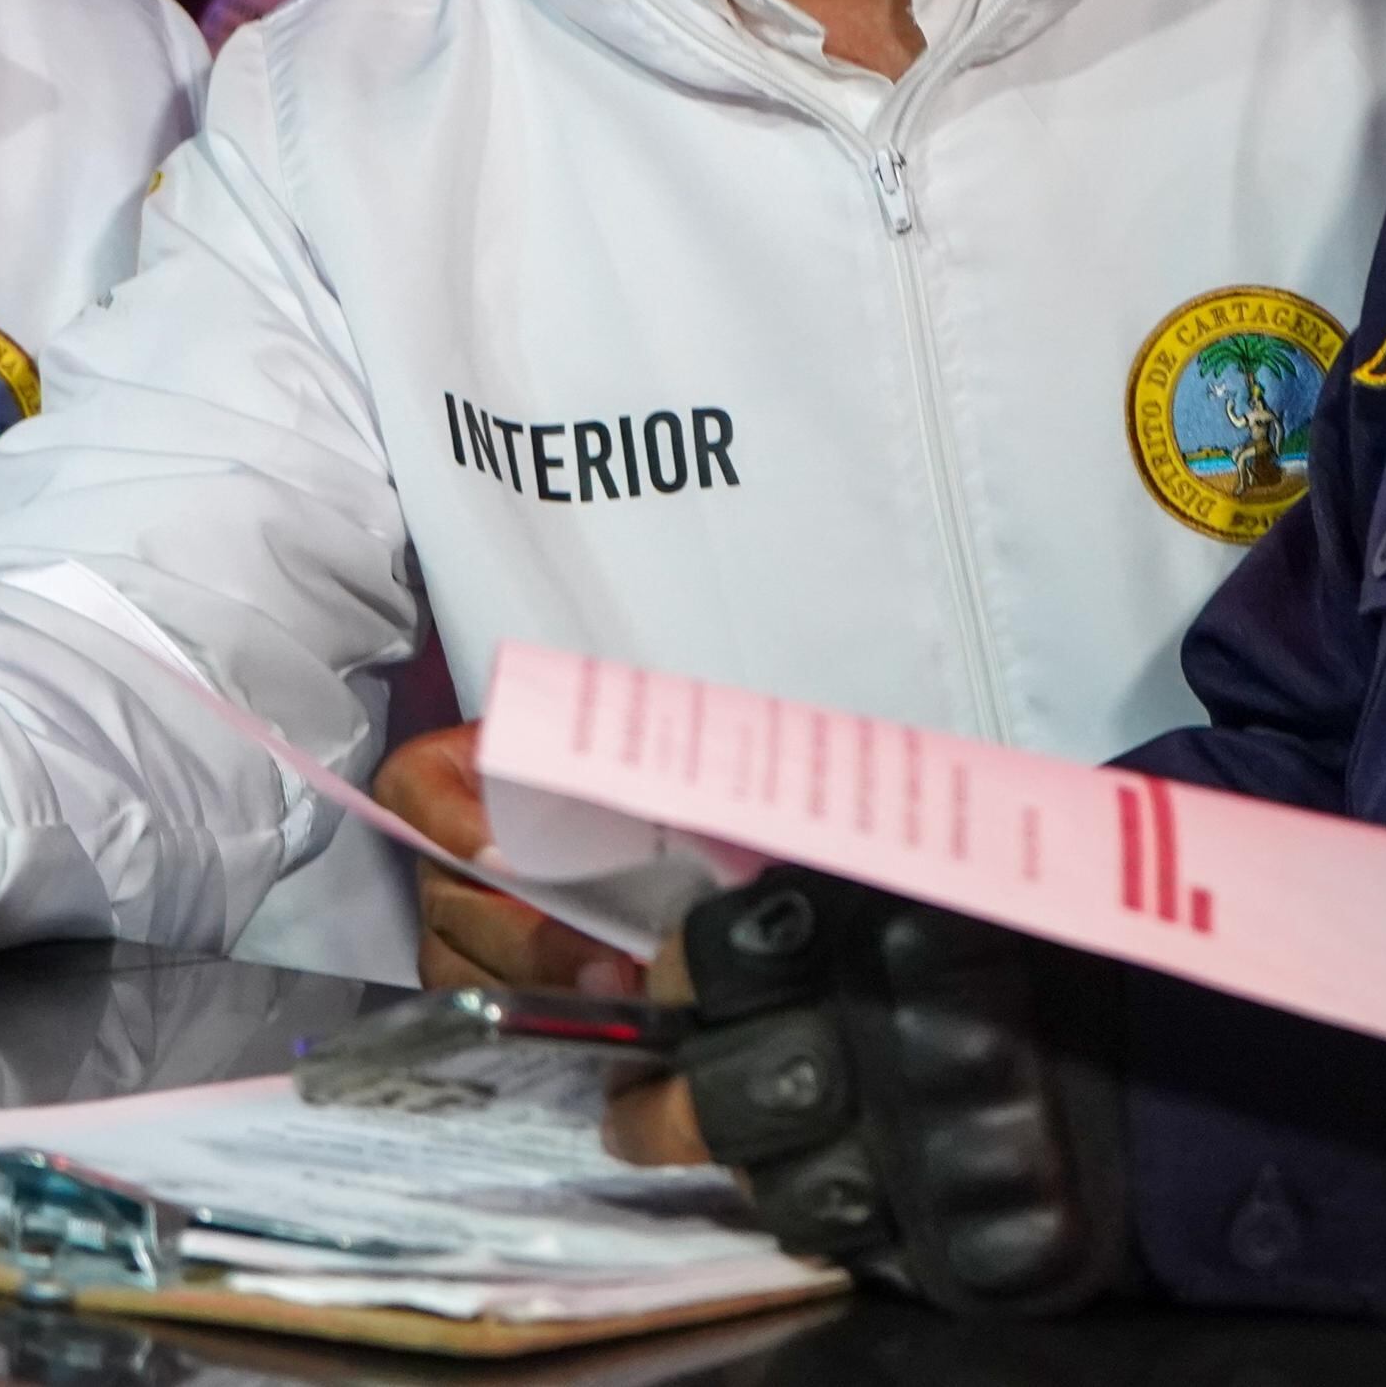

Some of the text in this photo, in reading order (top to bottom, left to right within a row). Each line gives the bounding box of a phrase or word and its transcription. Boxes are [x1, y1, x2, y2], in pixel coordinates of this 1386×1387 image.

[1146, 349, 1178, 391] DE
[444, 390, 741, 502] INTERIOR
[1141, 399, 1217, 519] DISTRITO
